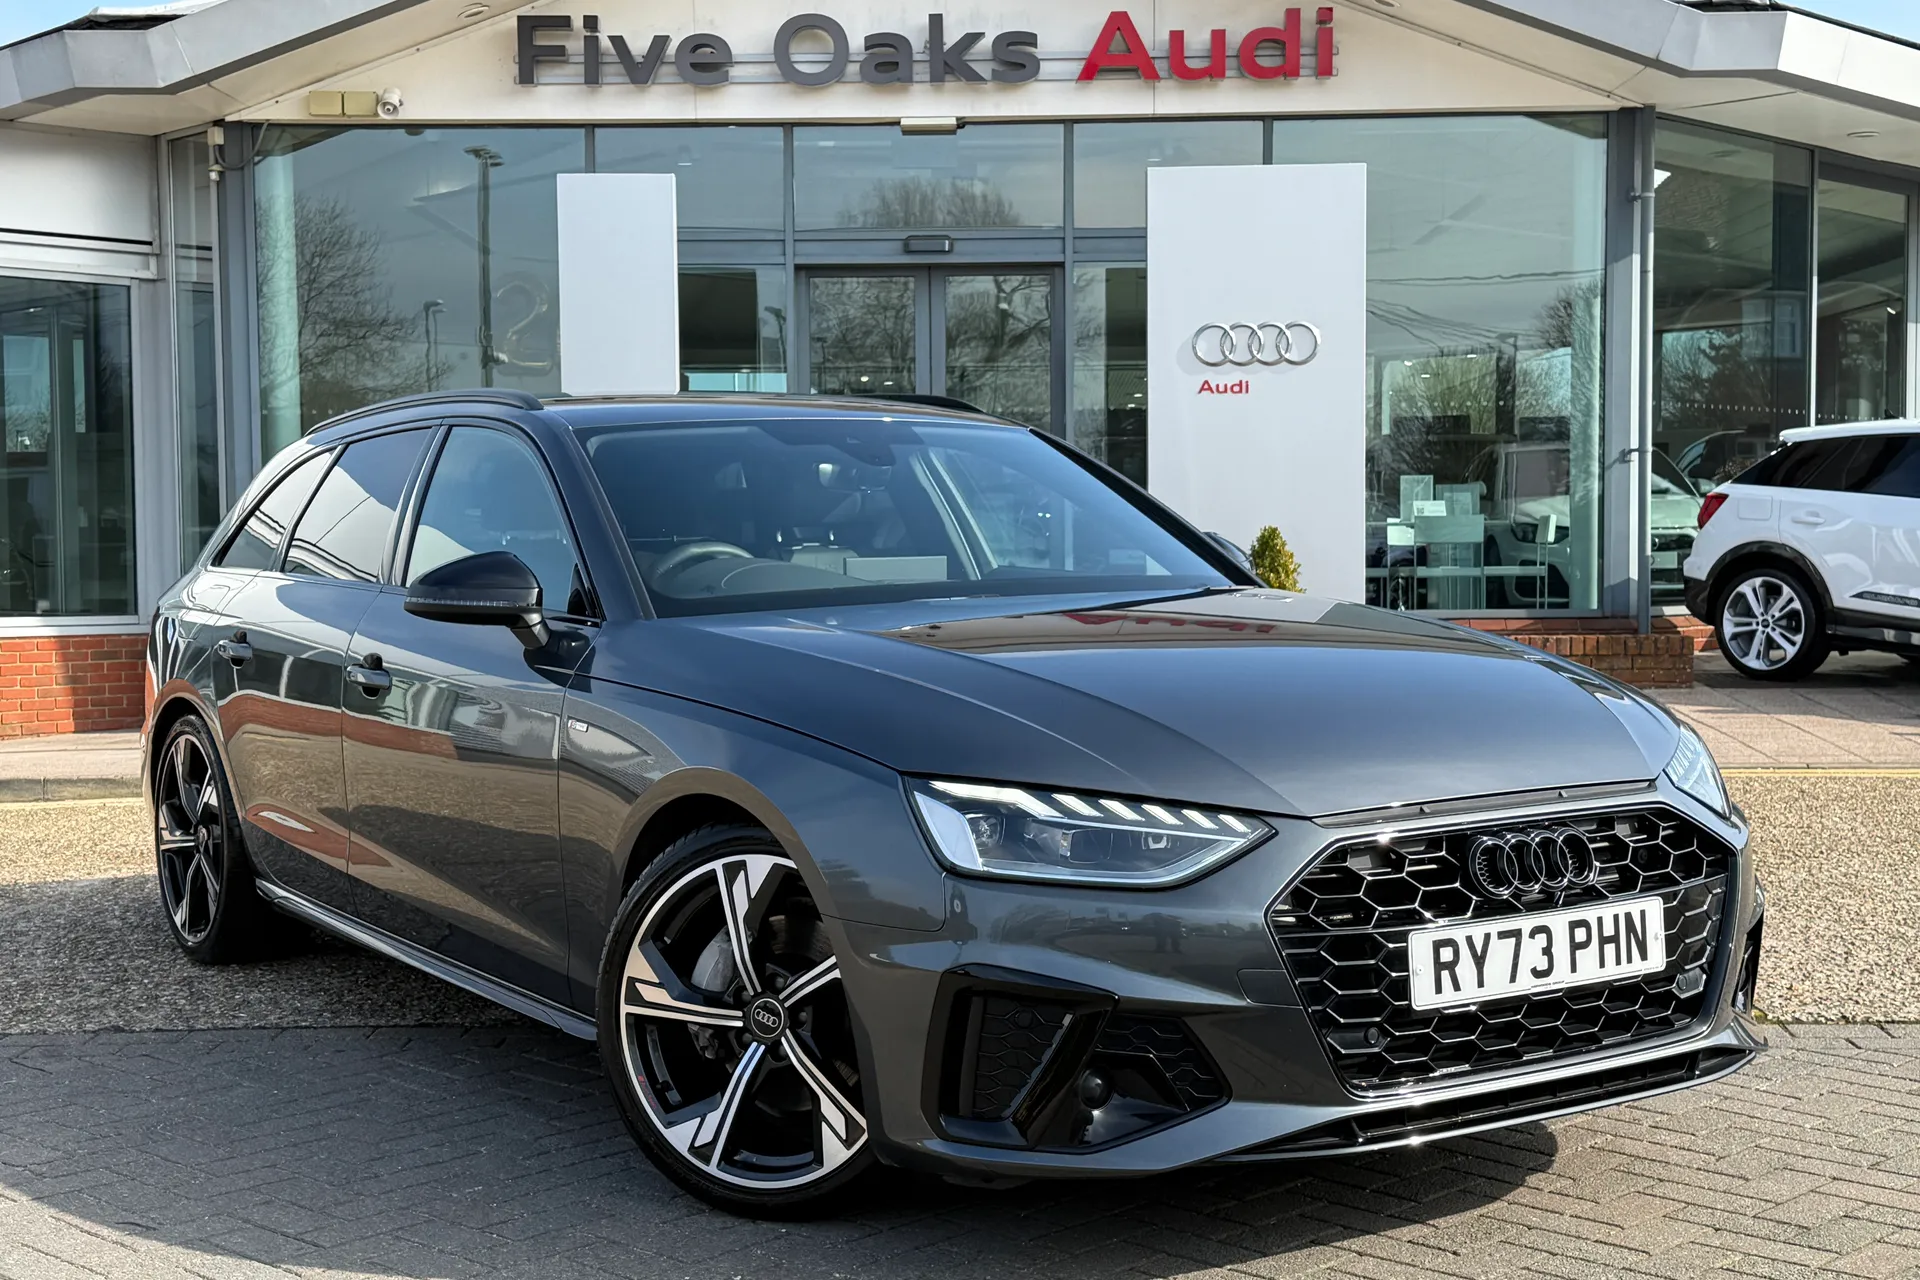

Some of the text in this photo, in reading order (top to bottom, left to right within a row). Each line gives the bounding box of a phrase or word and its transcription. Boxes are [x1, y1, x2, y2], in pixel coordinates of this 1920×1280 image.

[517, 7, 1334, 87] Five Oaks Audi
[1197, 379, 1250, 395] Audi
[1431, 908, 1649, 996] RY73 PHN
